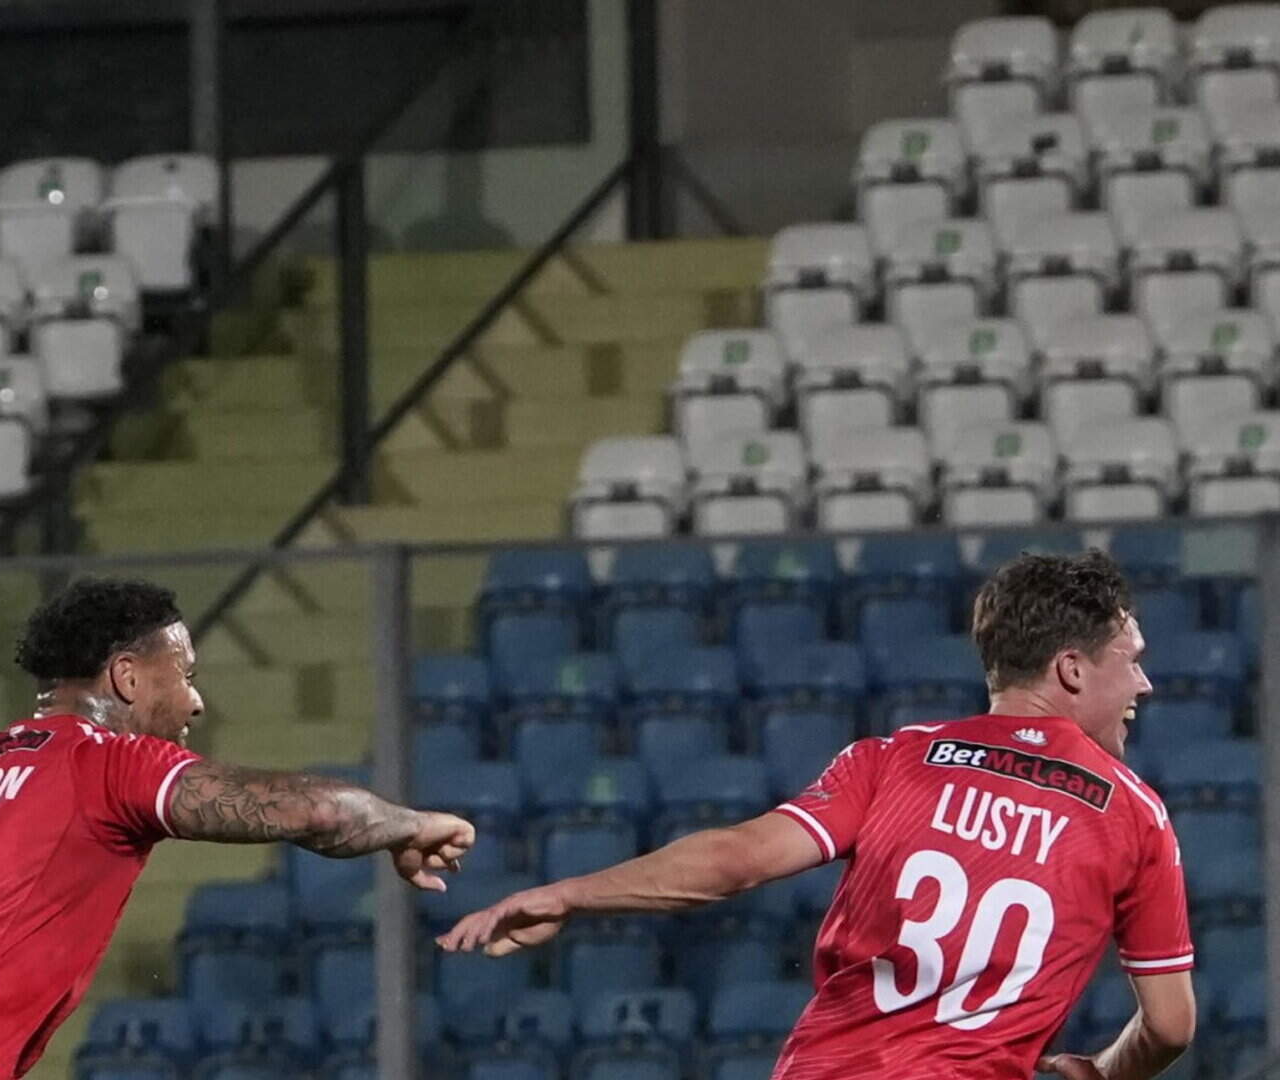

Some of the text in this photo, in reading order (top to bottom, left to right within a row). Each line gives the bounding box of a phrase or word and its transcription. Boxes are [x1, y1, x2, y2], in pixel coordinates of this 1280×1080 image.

[931, 743, 1105, 807] BetMcLean
[930, 783, 1069, 866] LUSTY
[872, 849, 1055, 1030] 30
